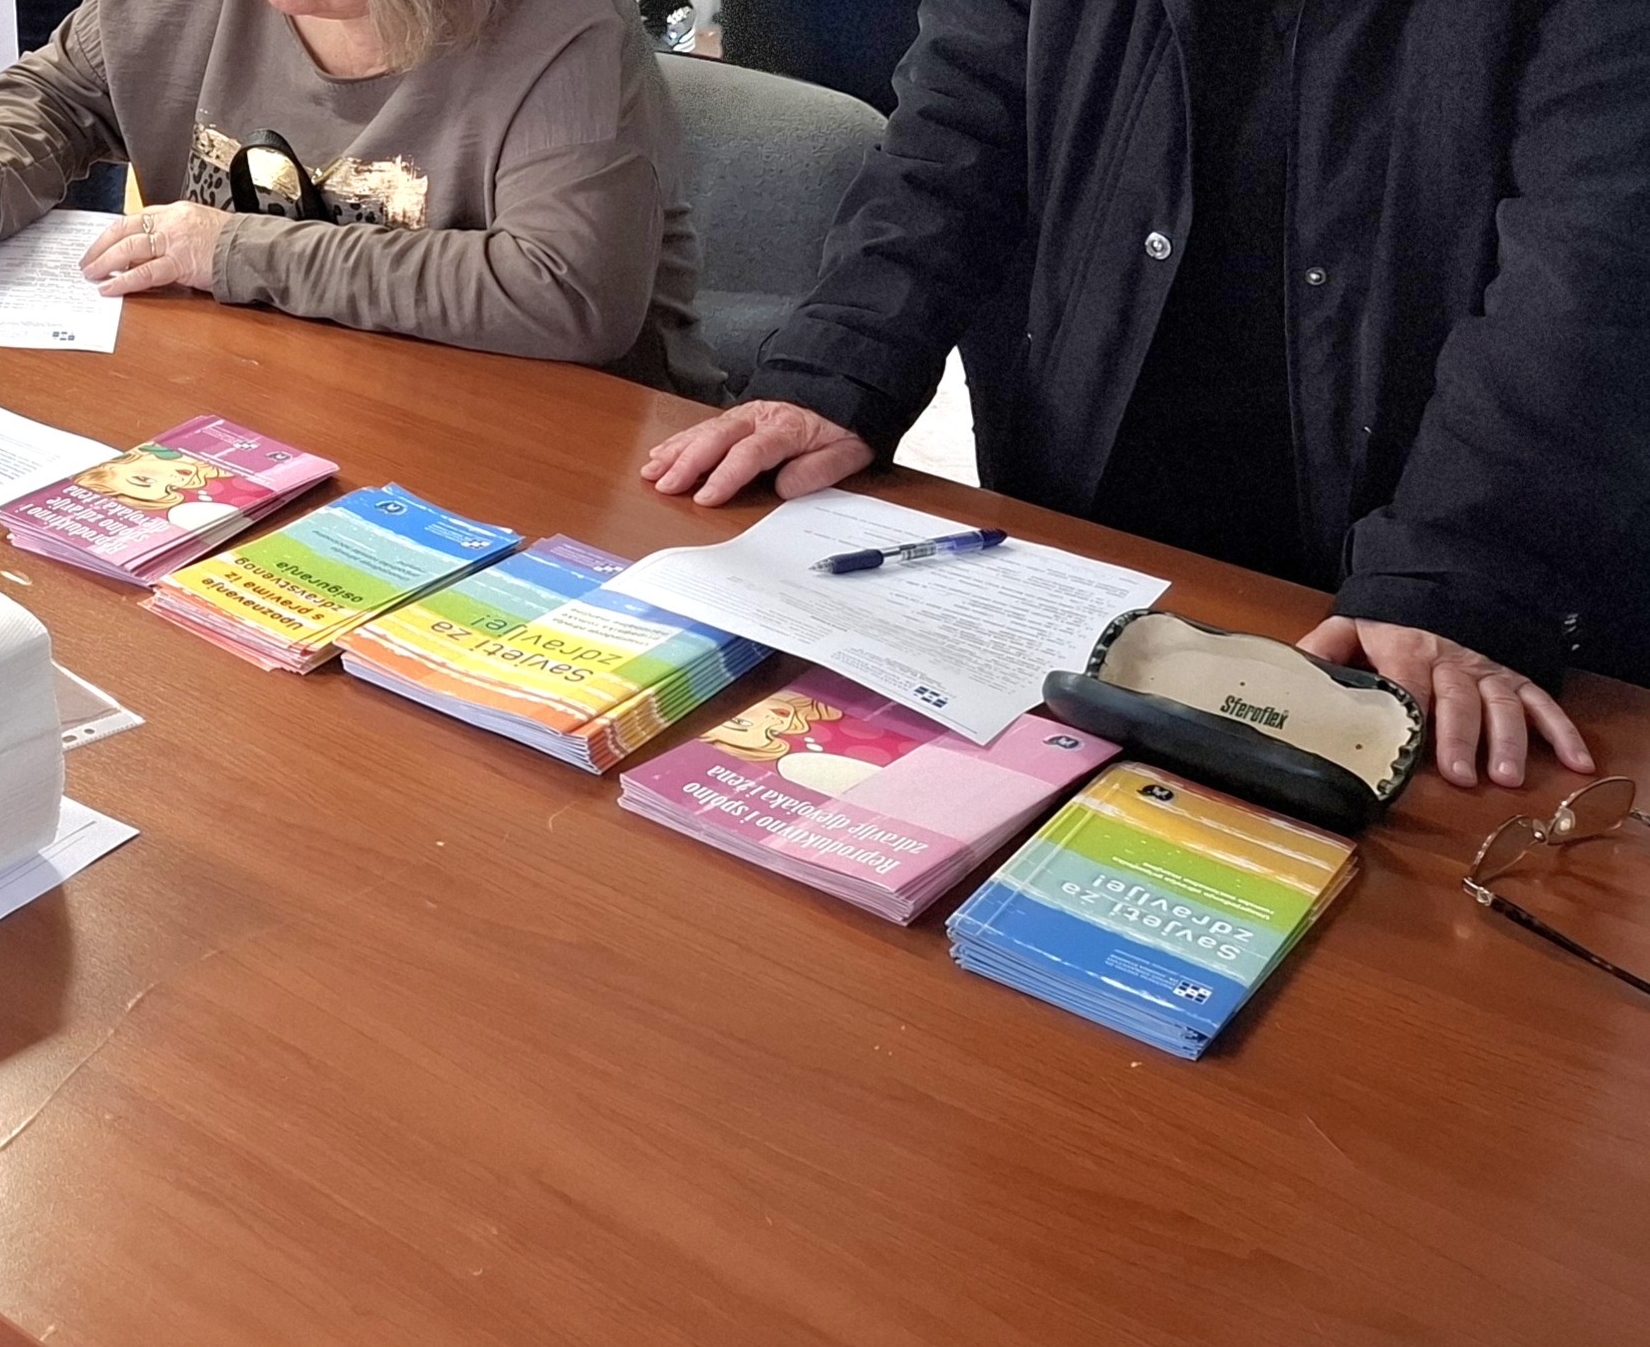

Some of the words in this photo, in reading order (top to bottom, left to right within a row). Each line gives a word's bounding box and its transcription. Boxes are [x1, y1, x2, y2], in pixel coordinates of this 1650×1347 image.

[15, 503, 34, 513] i
[46, 497, 105, 522] zdravlje
[102, 498, 170, 534] djevojaka
[27, 506, 128, 554] Reproduktivno
[99, 519, 149, 542] spolno
[224, 571, 242, 583] iz
[235, 557, 346, 612] zdravstvenog
[276, 561, 363, 603] osiguranja
[202, 577, 304, 631] Upoznavanje
[243, 582, 314, 615] pravima
[431, 621, 472, 641] za
[471, 615, 624, 665] zdravlje!
[470, 639, 594, 682] Savjeti
[1220, 694, 1288, 730] Sferoflex
[707, 765, 754, 793] žena
[746, 784, 763, 798] i
[683, 782, 749, 816] spolno
[761, 789, 851, 829] djevojaka
[740, 810, 758, 824] i
[755, 816, 902, 875] Reproduktivno
[849, 823, 928, 855] zdravlje
[1062, 881, 1100, 904] za
[1092, 875, 1254, 942] zdravlje!
[1109, 902, 1241, 961] Savjeti
